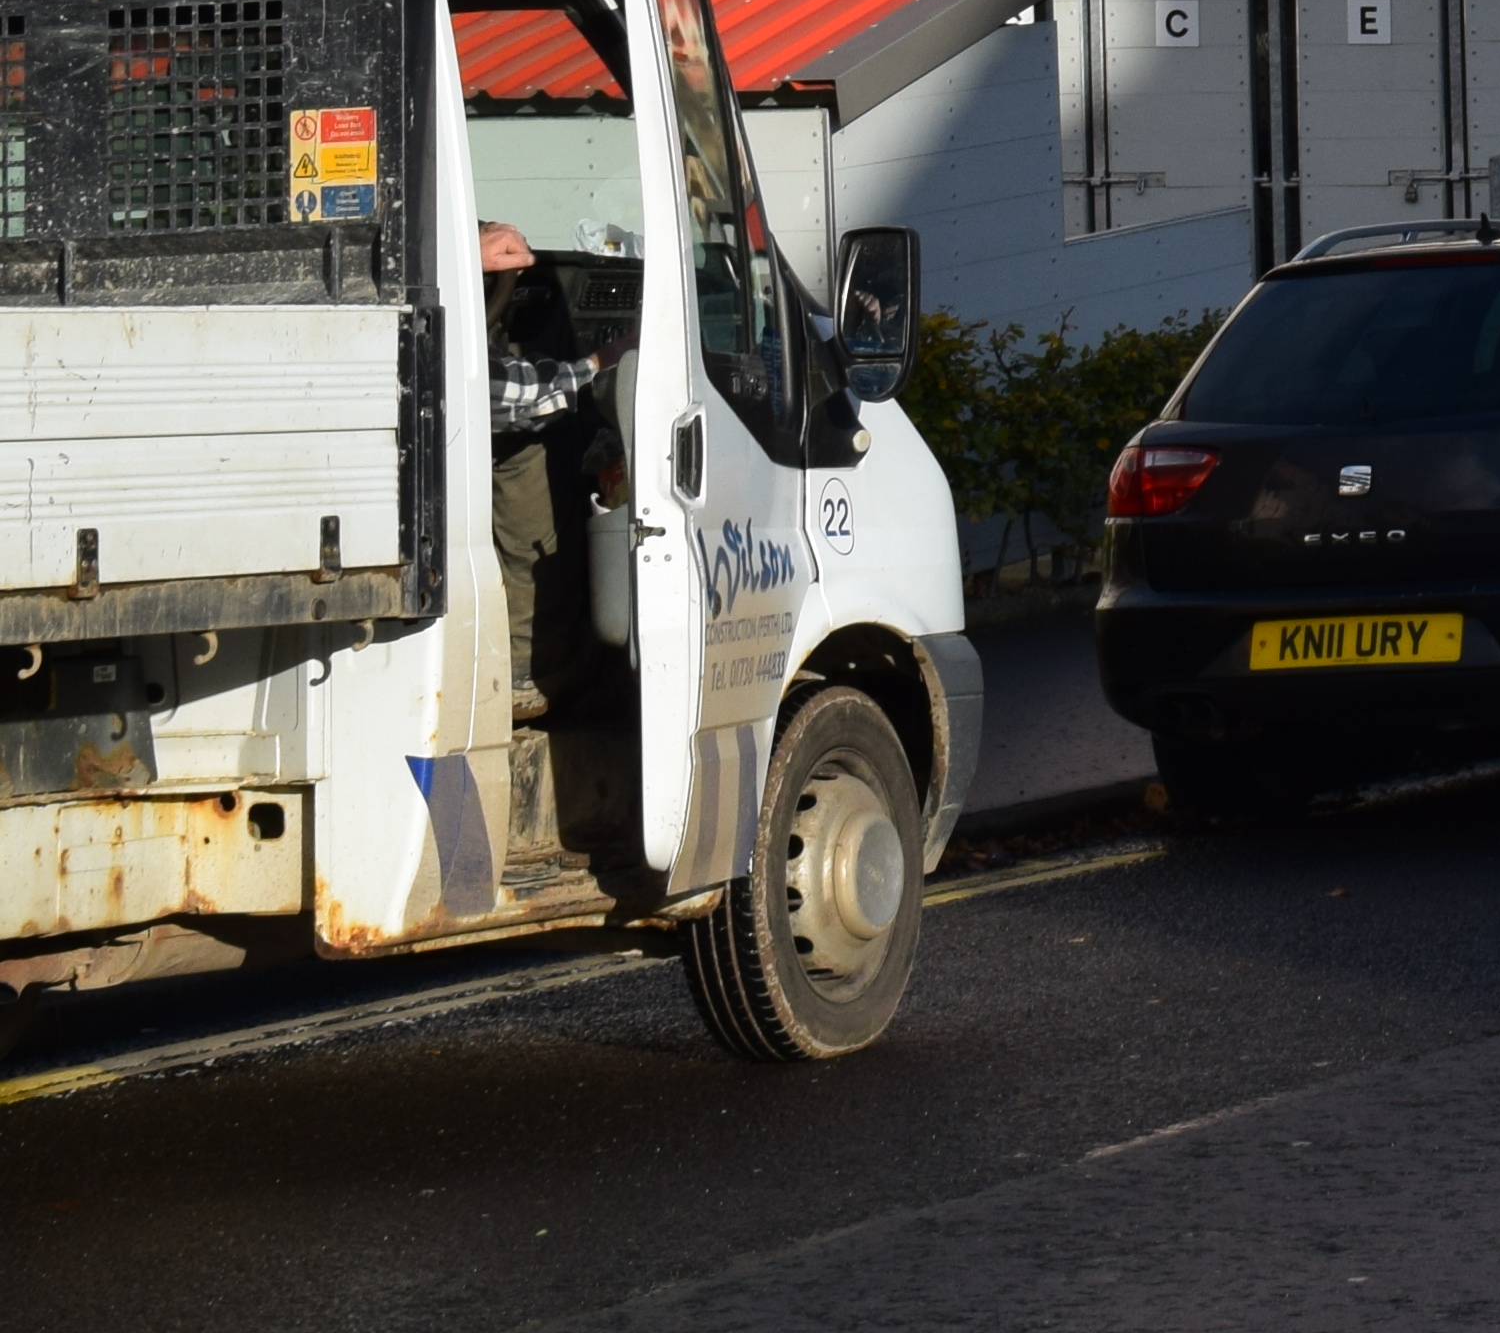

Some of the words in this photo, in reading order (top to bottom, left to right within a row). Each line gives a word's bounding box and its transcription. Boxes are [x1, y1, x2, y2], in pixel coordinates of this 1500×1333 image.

[1165, 9, 1189, 38] C
[1359, 6, 1378, 35] E
[823, 498, 851, 537] 22
[1304, 530, 1406, 544] EXEO
[698, 516, 795, 620] Wilson
[706, 618, 756, 647] CONSTRUCTION
[1279, 623, 1345, 661] KN11
[1355, 620, 1429, 658] URY
